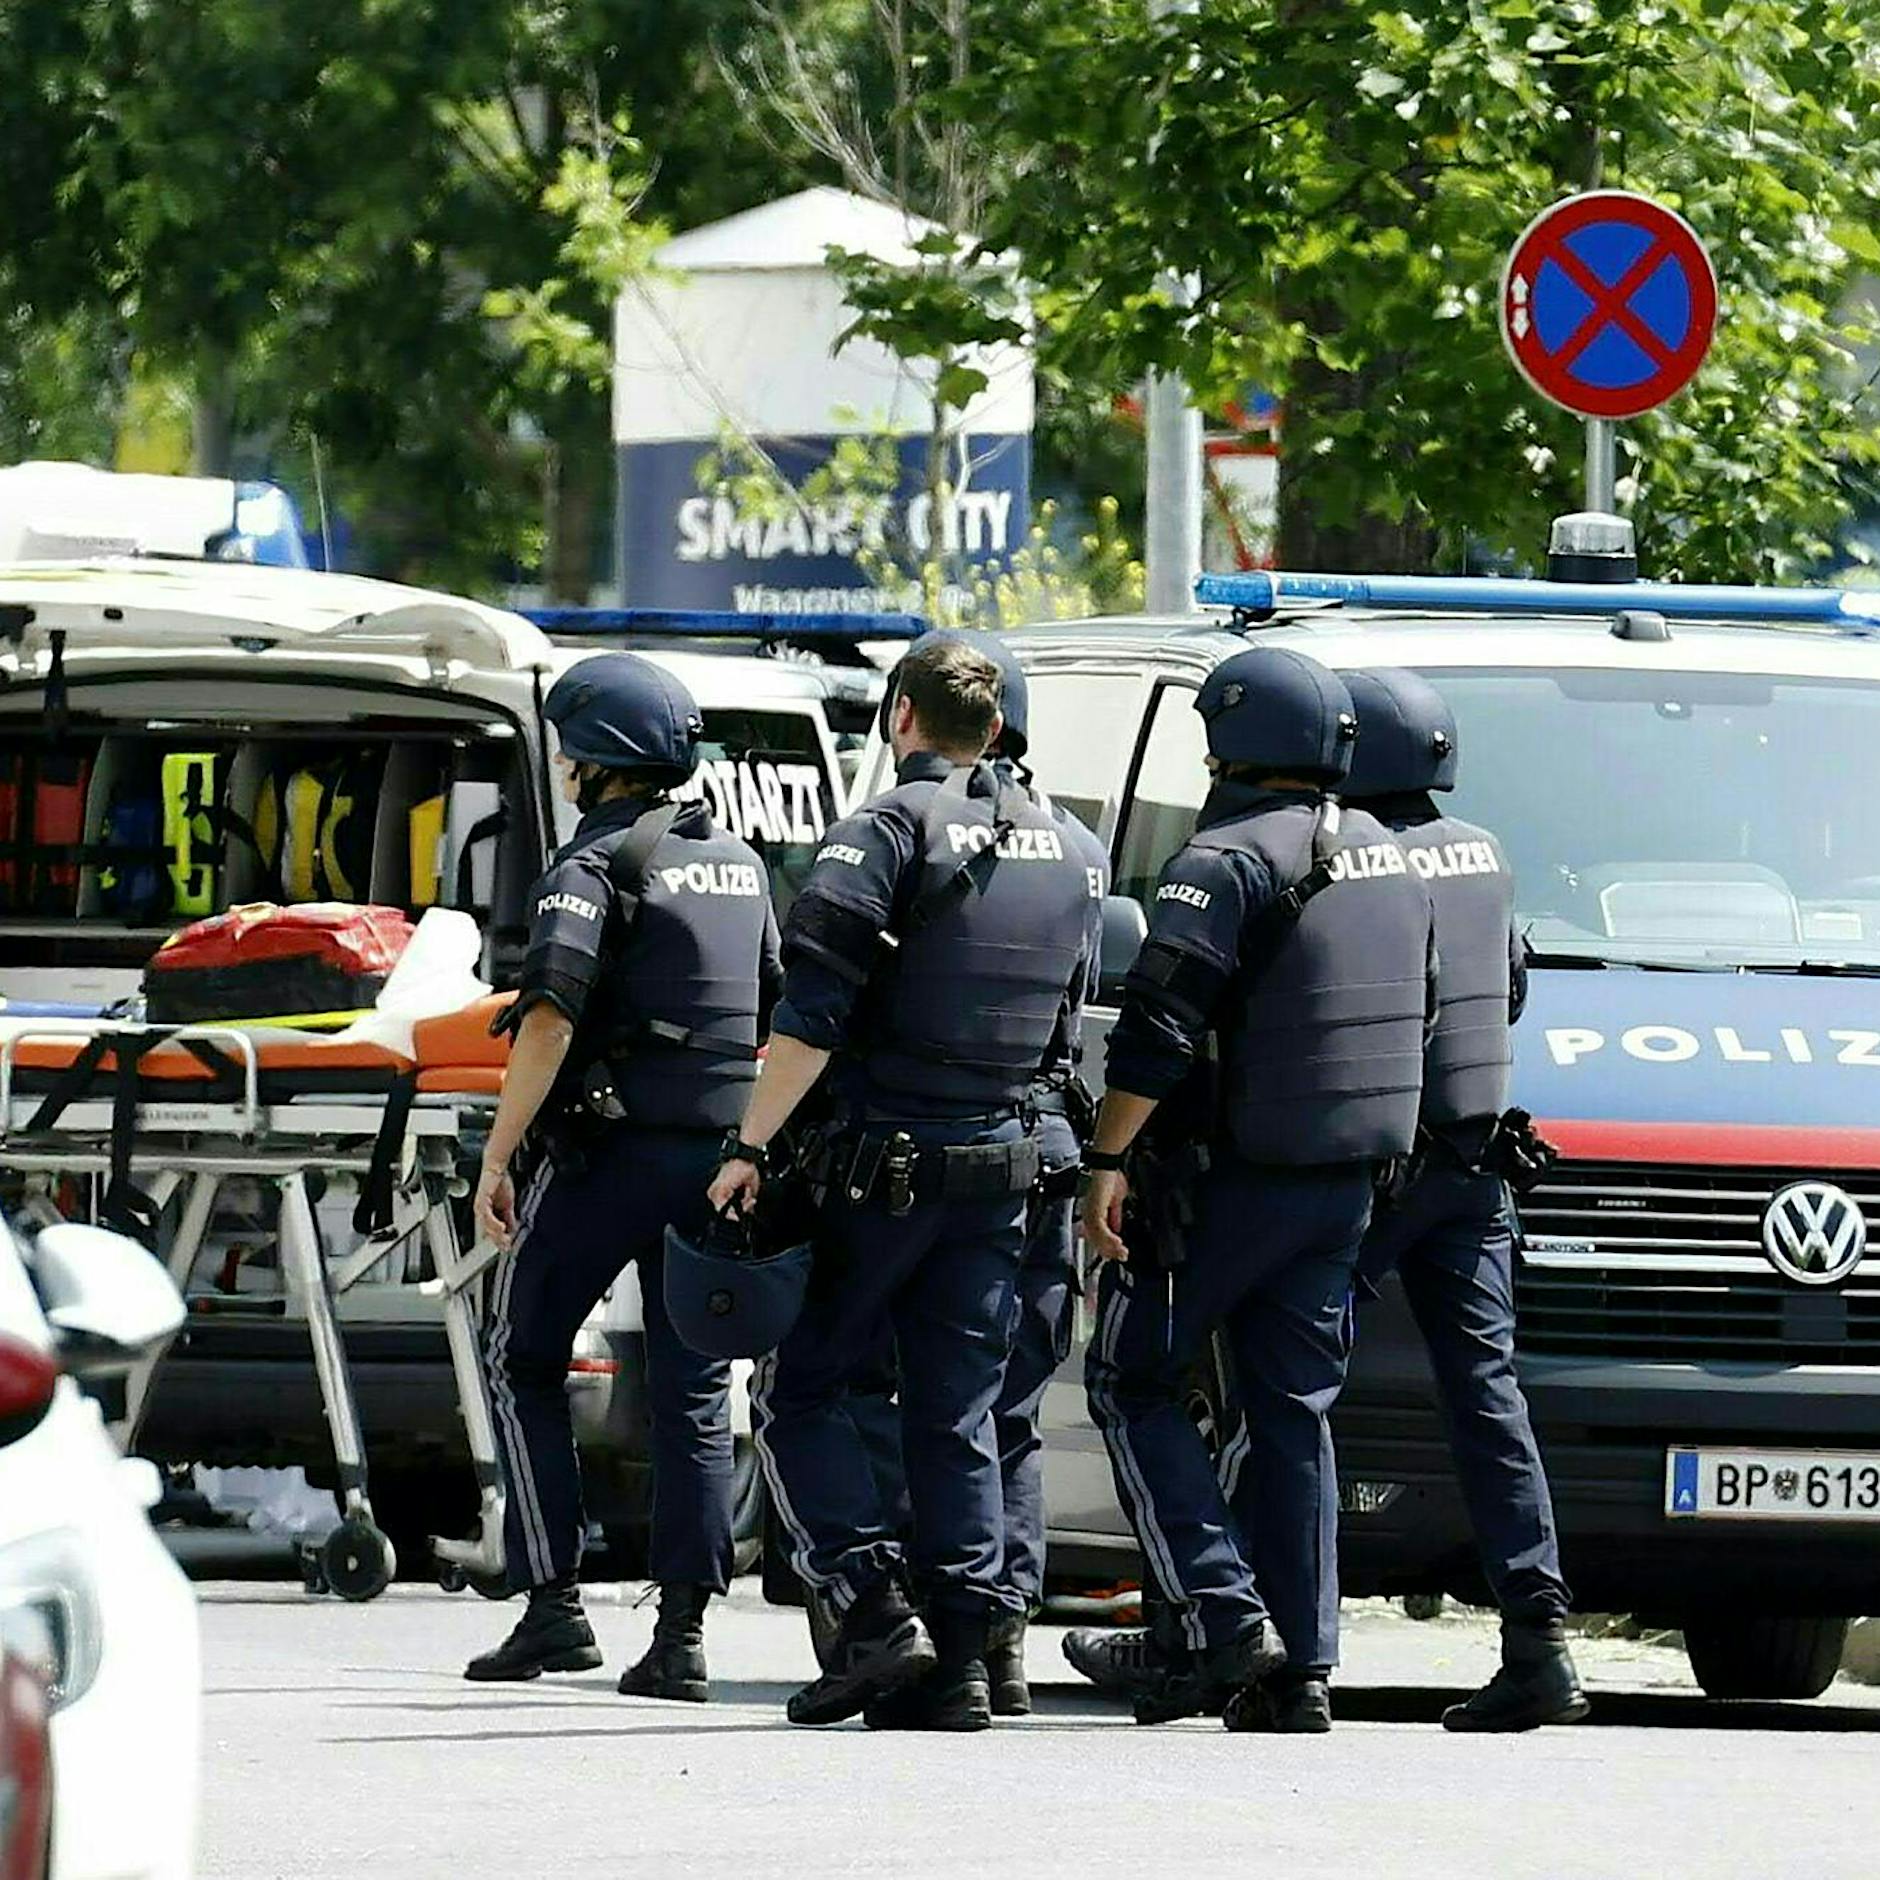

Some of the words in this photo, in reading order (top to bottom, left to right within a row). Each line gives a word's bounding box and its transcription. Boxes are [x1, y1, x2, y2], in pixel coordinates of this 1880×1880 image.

[675, 496, 891, 561] SMART
[908, 490, 1011, 551] CITY
[946, 823, 1063, 861] POLIZEI
[1408, 841, 1499, 879] OLIZEI
[661, 862, 760, 896] POLIZEI
[1328, 843, 1407, 881] OLIZEI
[537, 892, 598, 921] POLIZEI
[1156, 883, 1211, 909] POLIZEI
[1545, 1025, 1880, 1067] POLIZ
[1717, 1463, 1769, 1506] BP
[1807, 1465, 1879, 1508] 613
